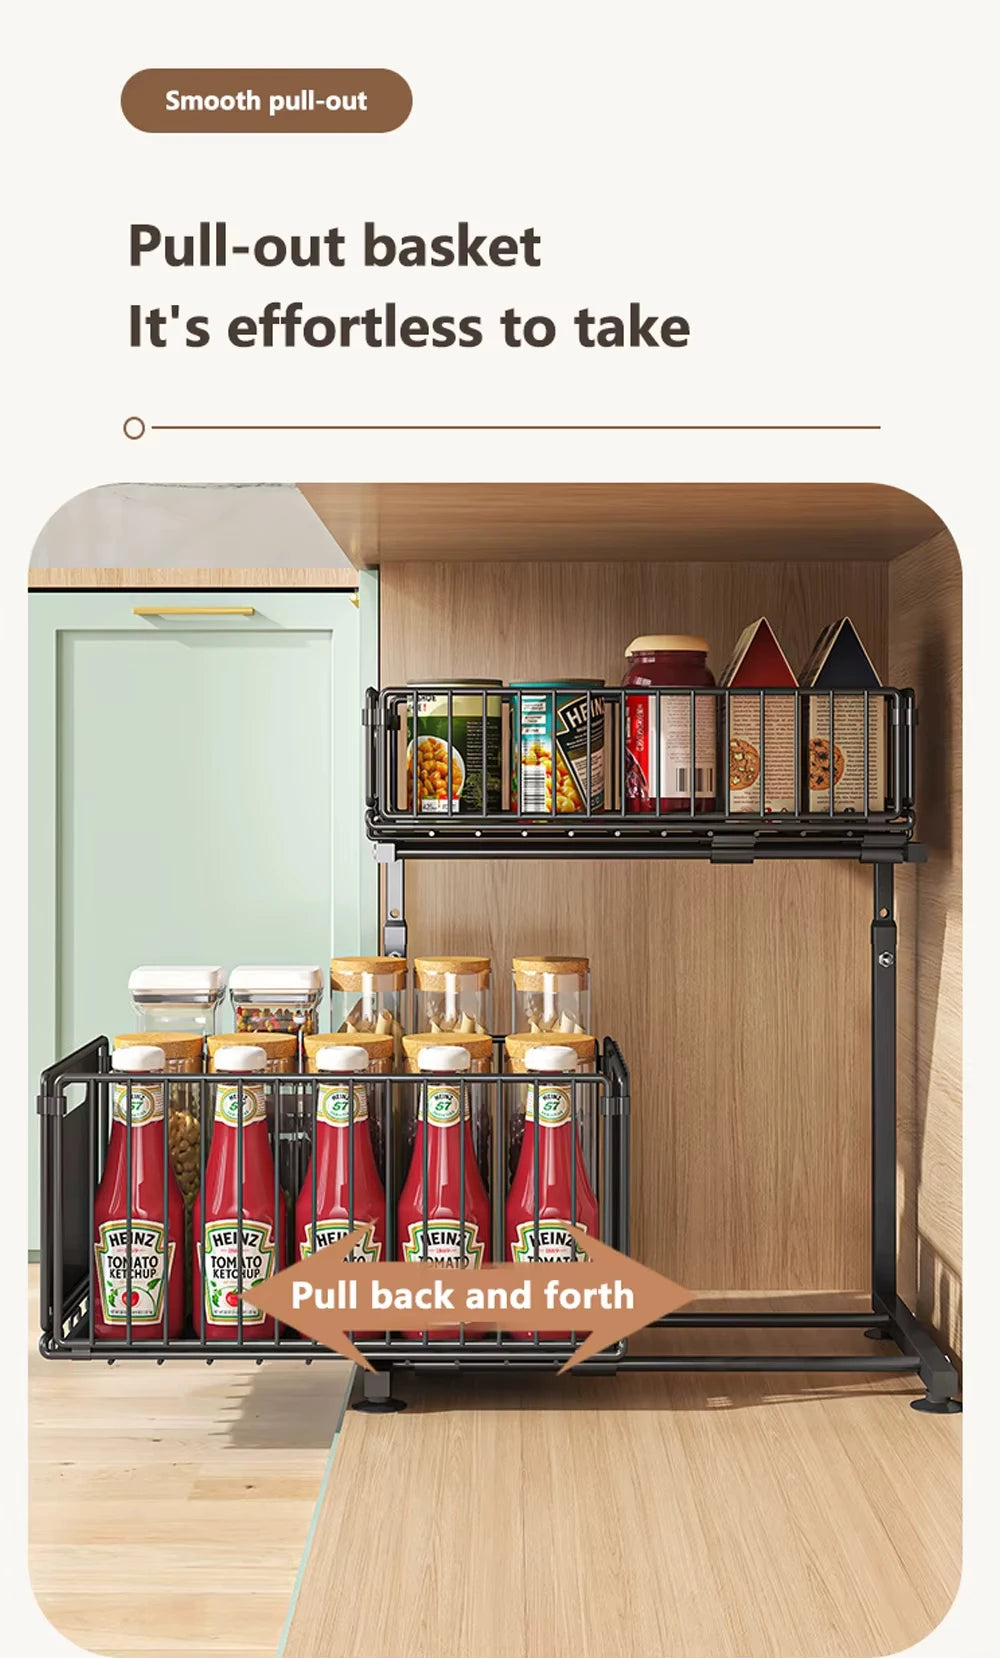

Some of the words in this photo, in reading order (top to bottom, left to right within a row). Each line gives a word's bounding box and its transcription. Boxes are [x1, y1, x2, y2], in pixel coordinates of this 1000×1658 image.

[332, 1101, 349, 1110] 57
[435, 1101, 452, 1110] 57
[543, 1101, 560, 1110] 57
[212, 1231, 260, 1247] HEINZ
